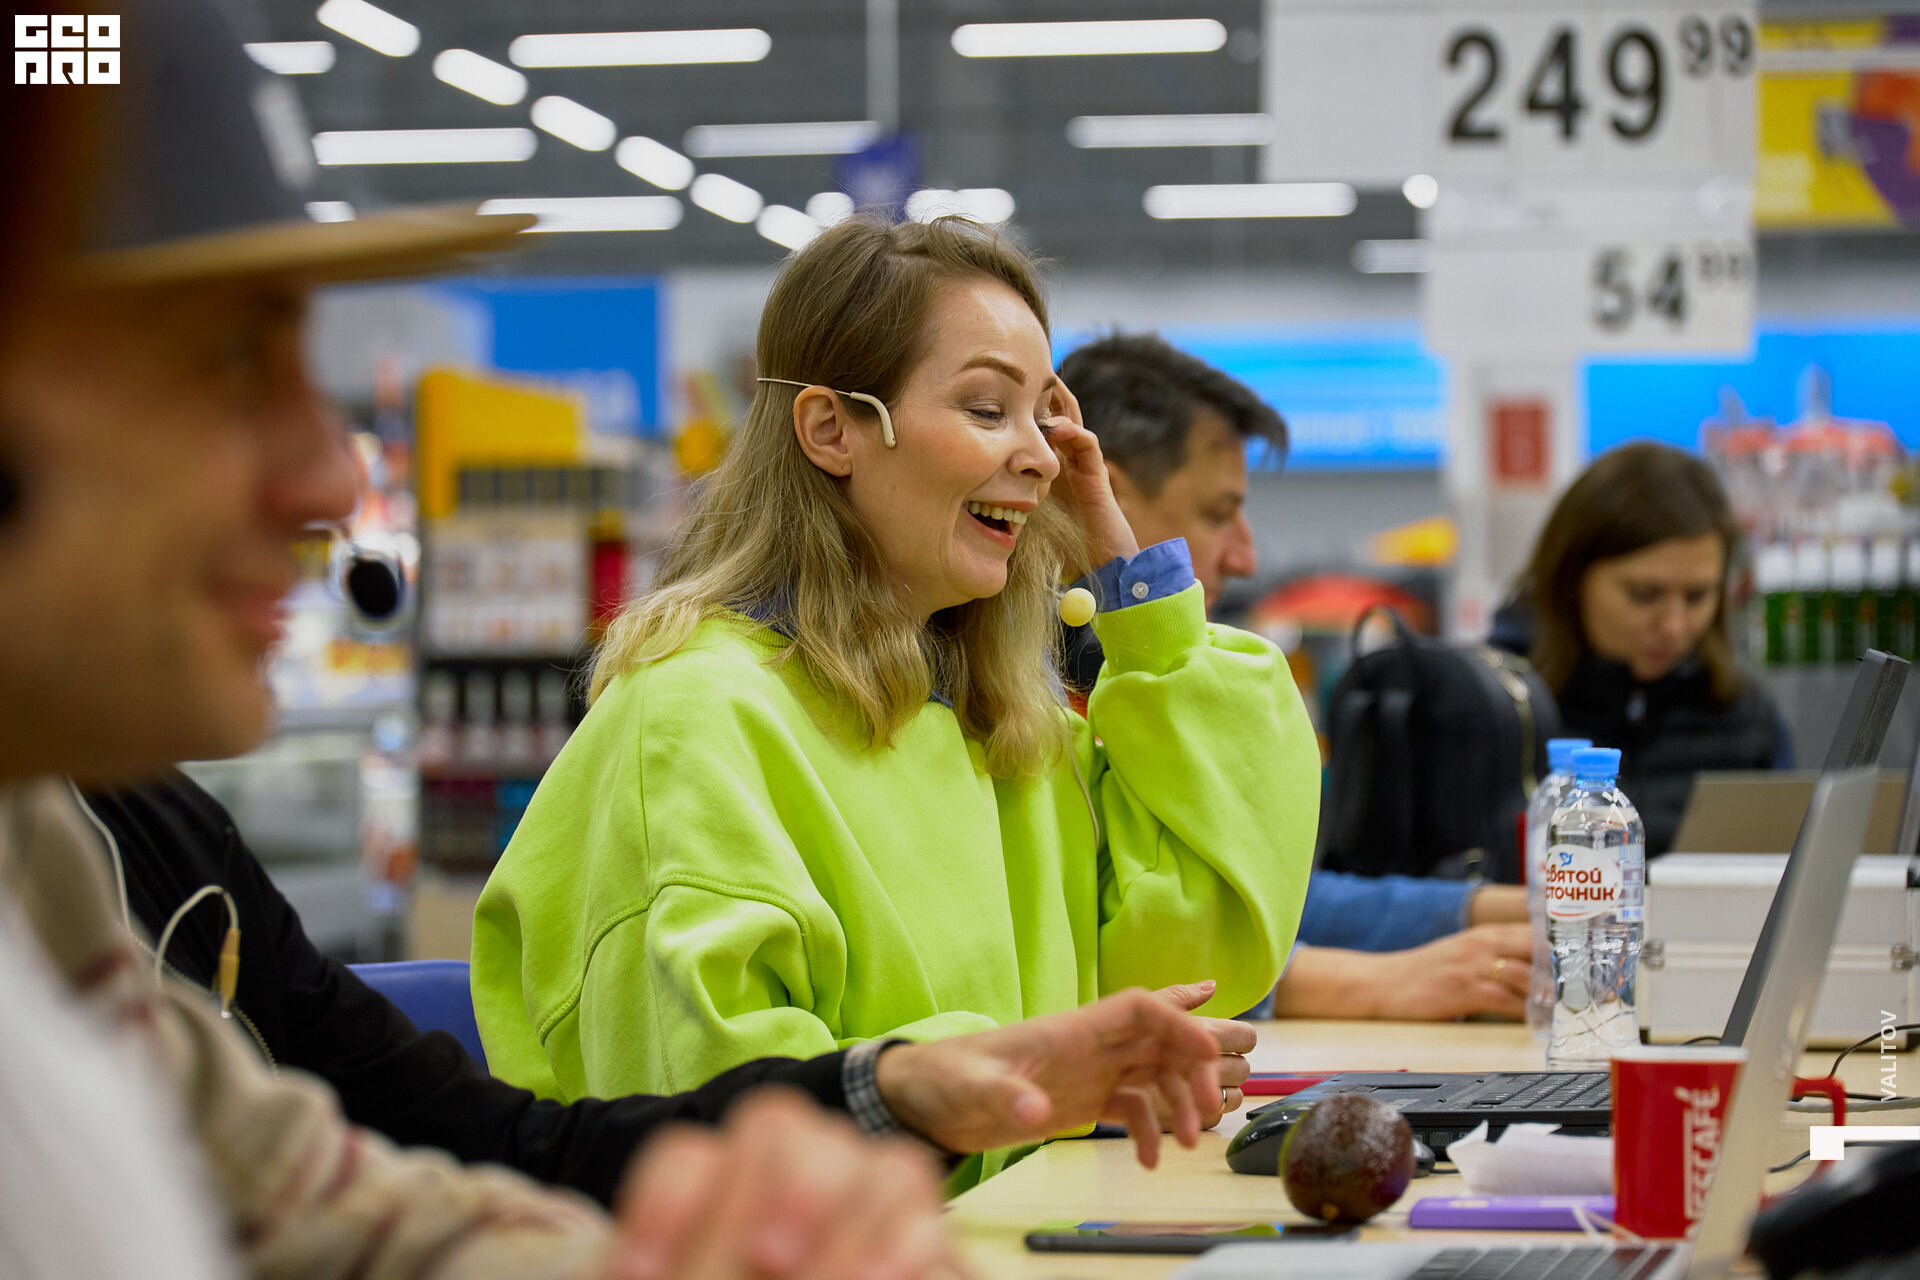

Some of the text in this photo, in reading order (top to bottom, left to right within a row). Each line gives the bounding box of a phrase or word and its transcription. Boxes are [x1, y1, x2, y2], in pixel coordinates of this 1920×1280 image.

[1445, 15, 1752, 144] 249 99
[1591, 246, 1688, 333] 54
